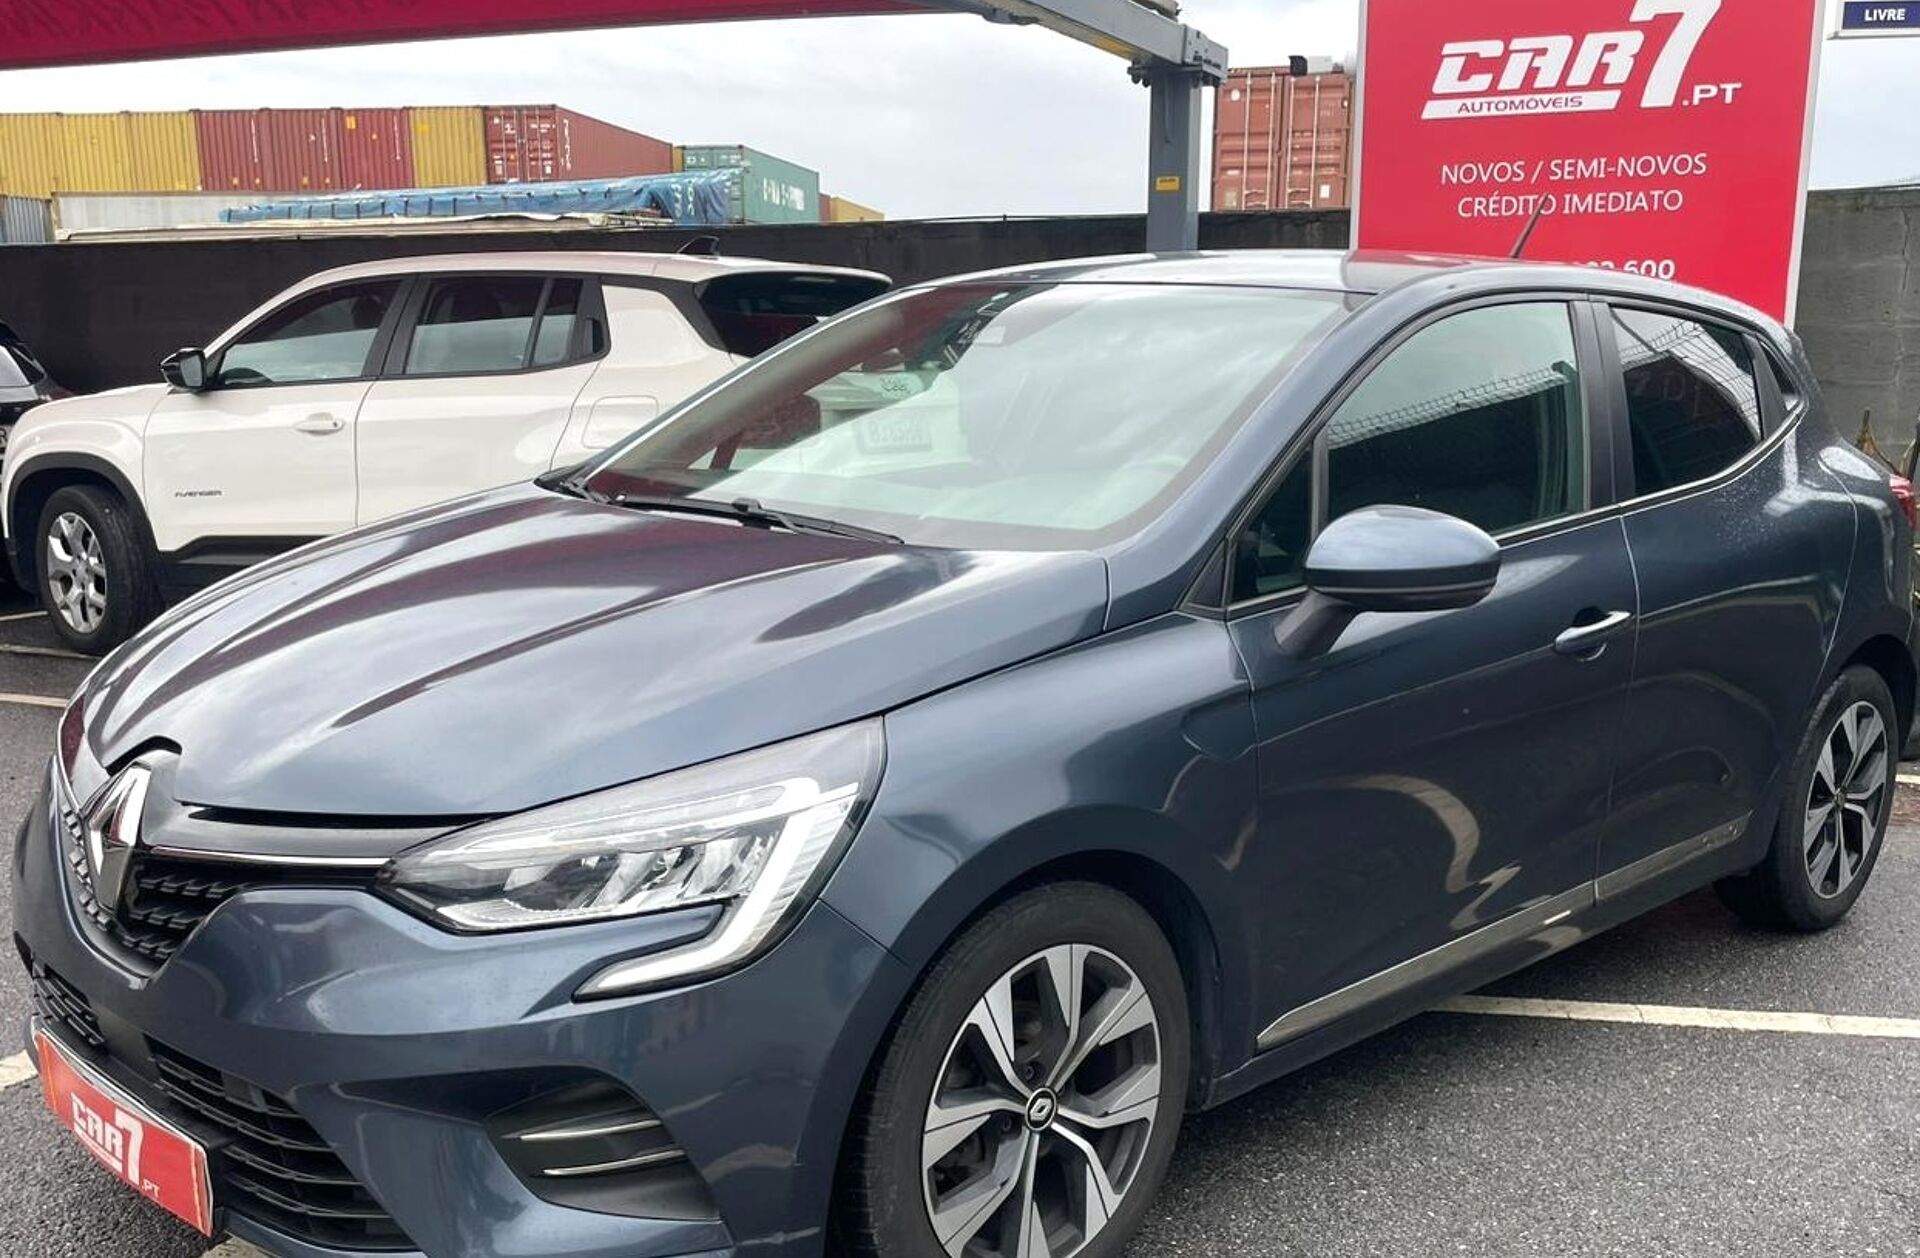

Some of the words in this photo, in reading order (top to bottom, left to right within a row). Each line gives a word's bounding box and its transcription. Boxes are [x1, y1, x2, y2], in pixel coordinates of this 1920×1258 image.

[1864, 8, 1906, 21] LIVRE
[1440, 161, 1526, 185] NOVOS
[1549, 153, 1708, 181] SEMI-NOVOS
[1457, 191, 1557, 218] CRÉDITO
[1562, 189, 1684, 215] IMEDIATO
